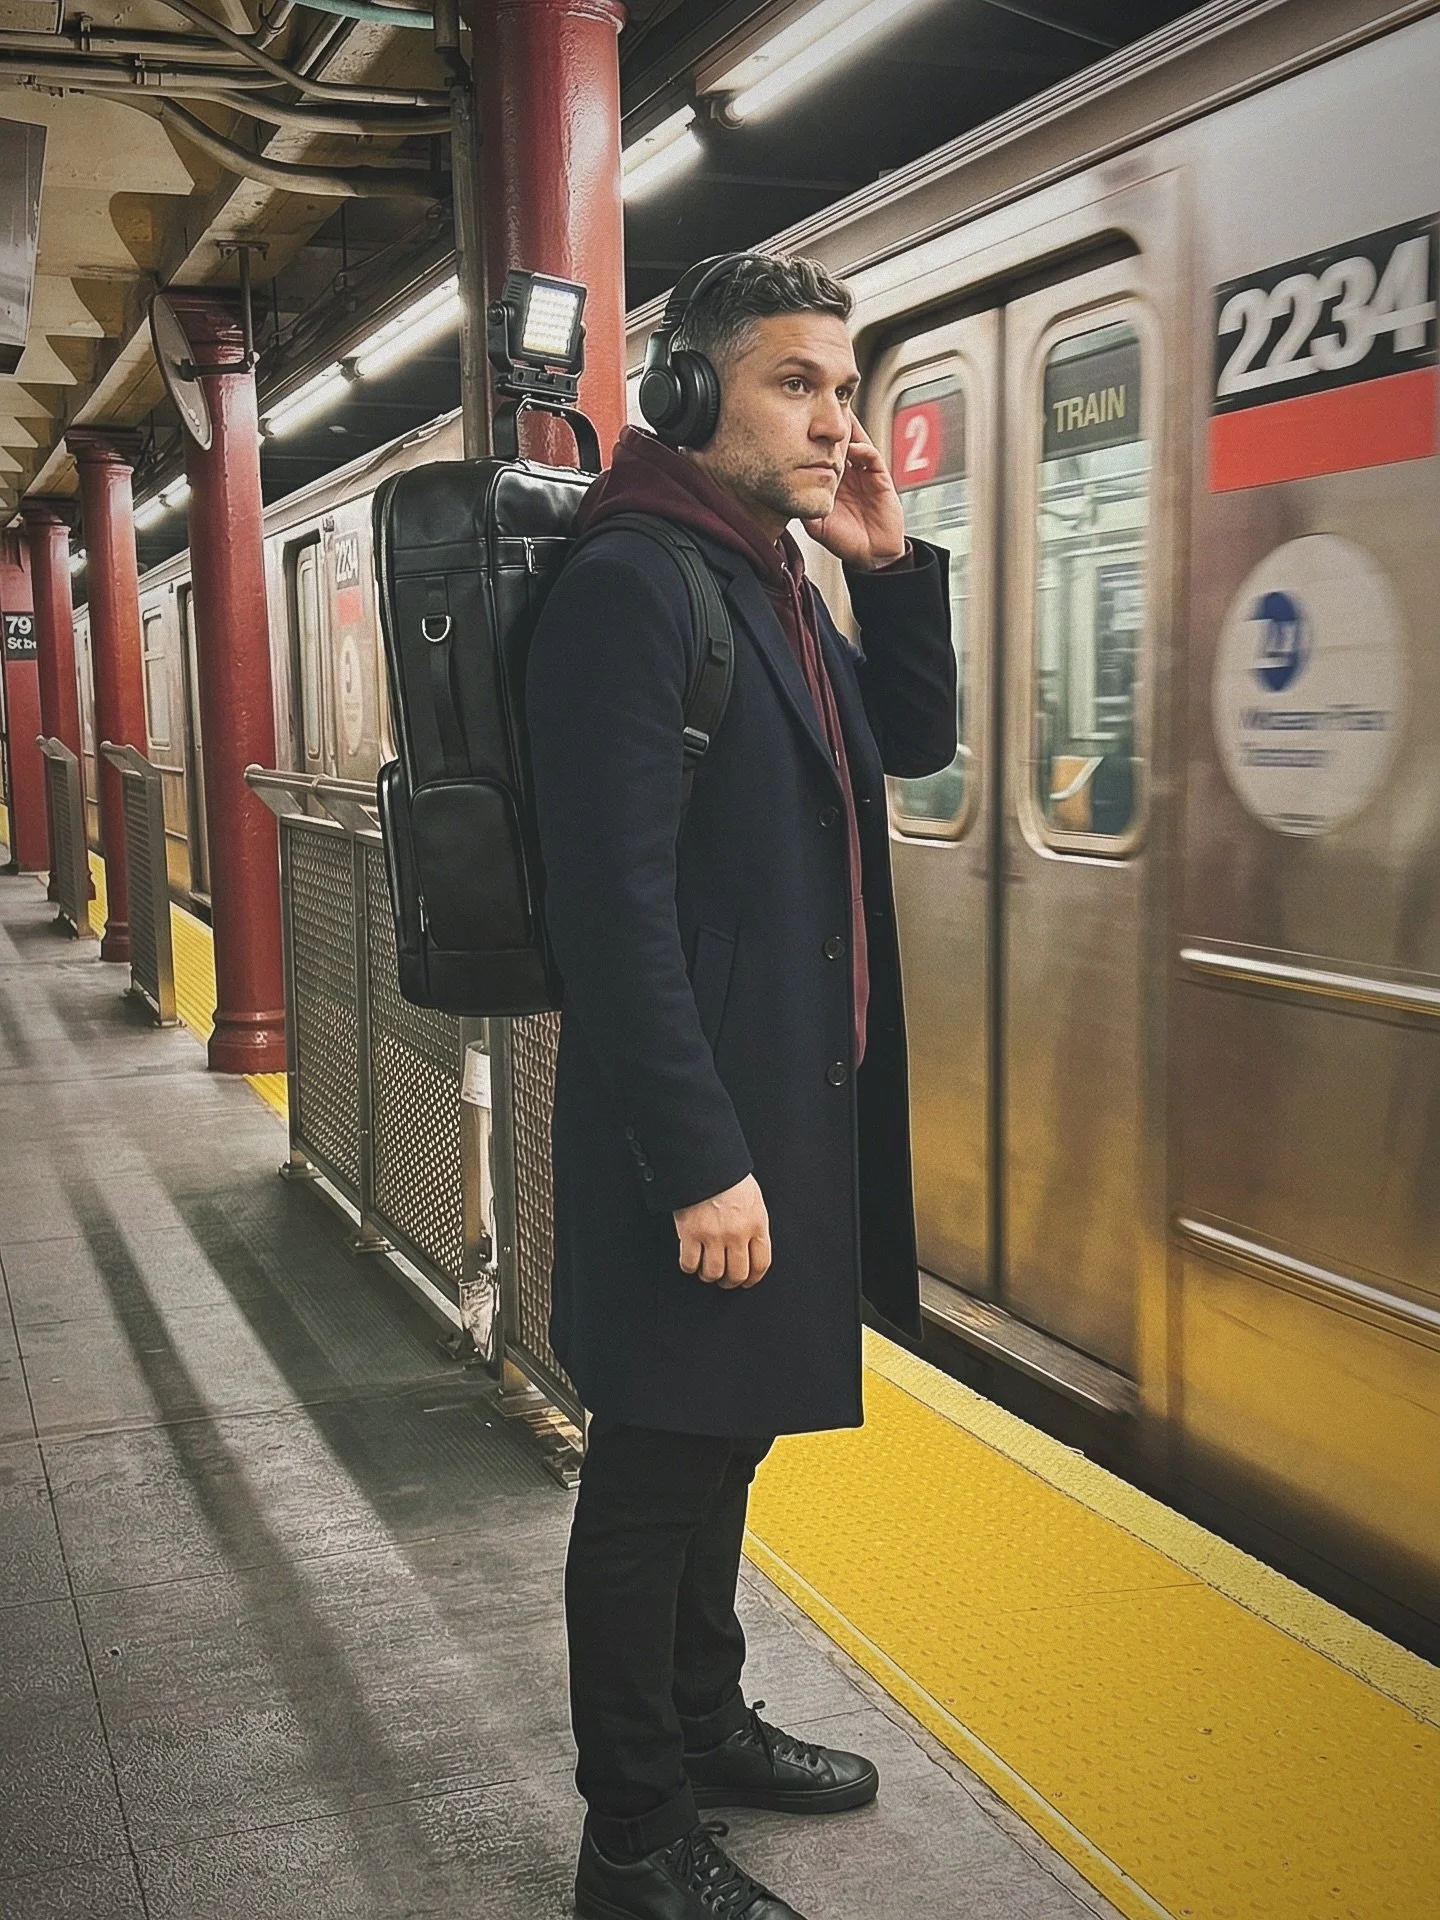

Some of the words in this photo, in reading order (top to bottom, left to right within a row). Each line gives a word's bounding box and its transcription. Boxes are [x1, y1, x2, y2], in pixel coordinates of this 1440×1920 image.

[1216, 235, 1437, 397] 2234
[1052, 384, 1127, 433] TRAIN
[903, 414, 931, 473] 2
[5, 615, 32, 635] 79
